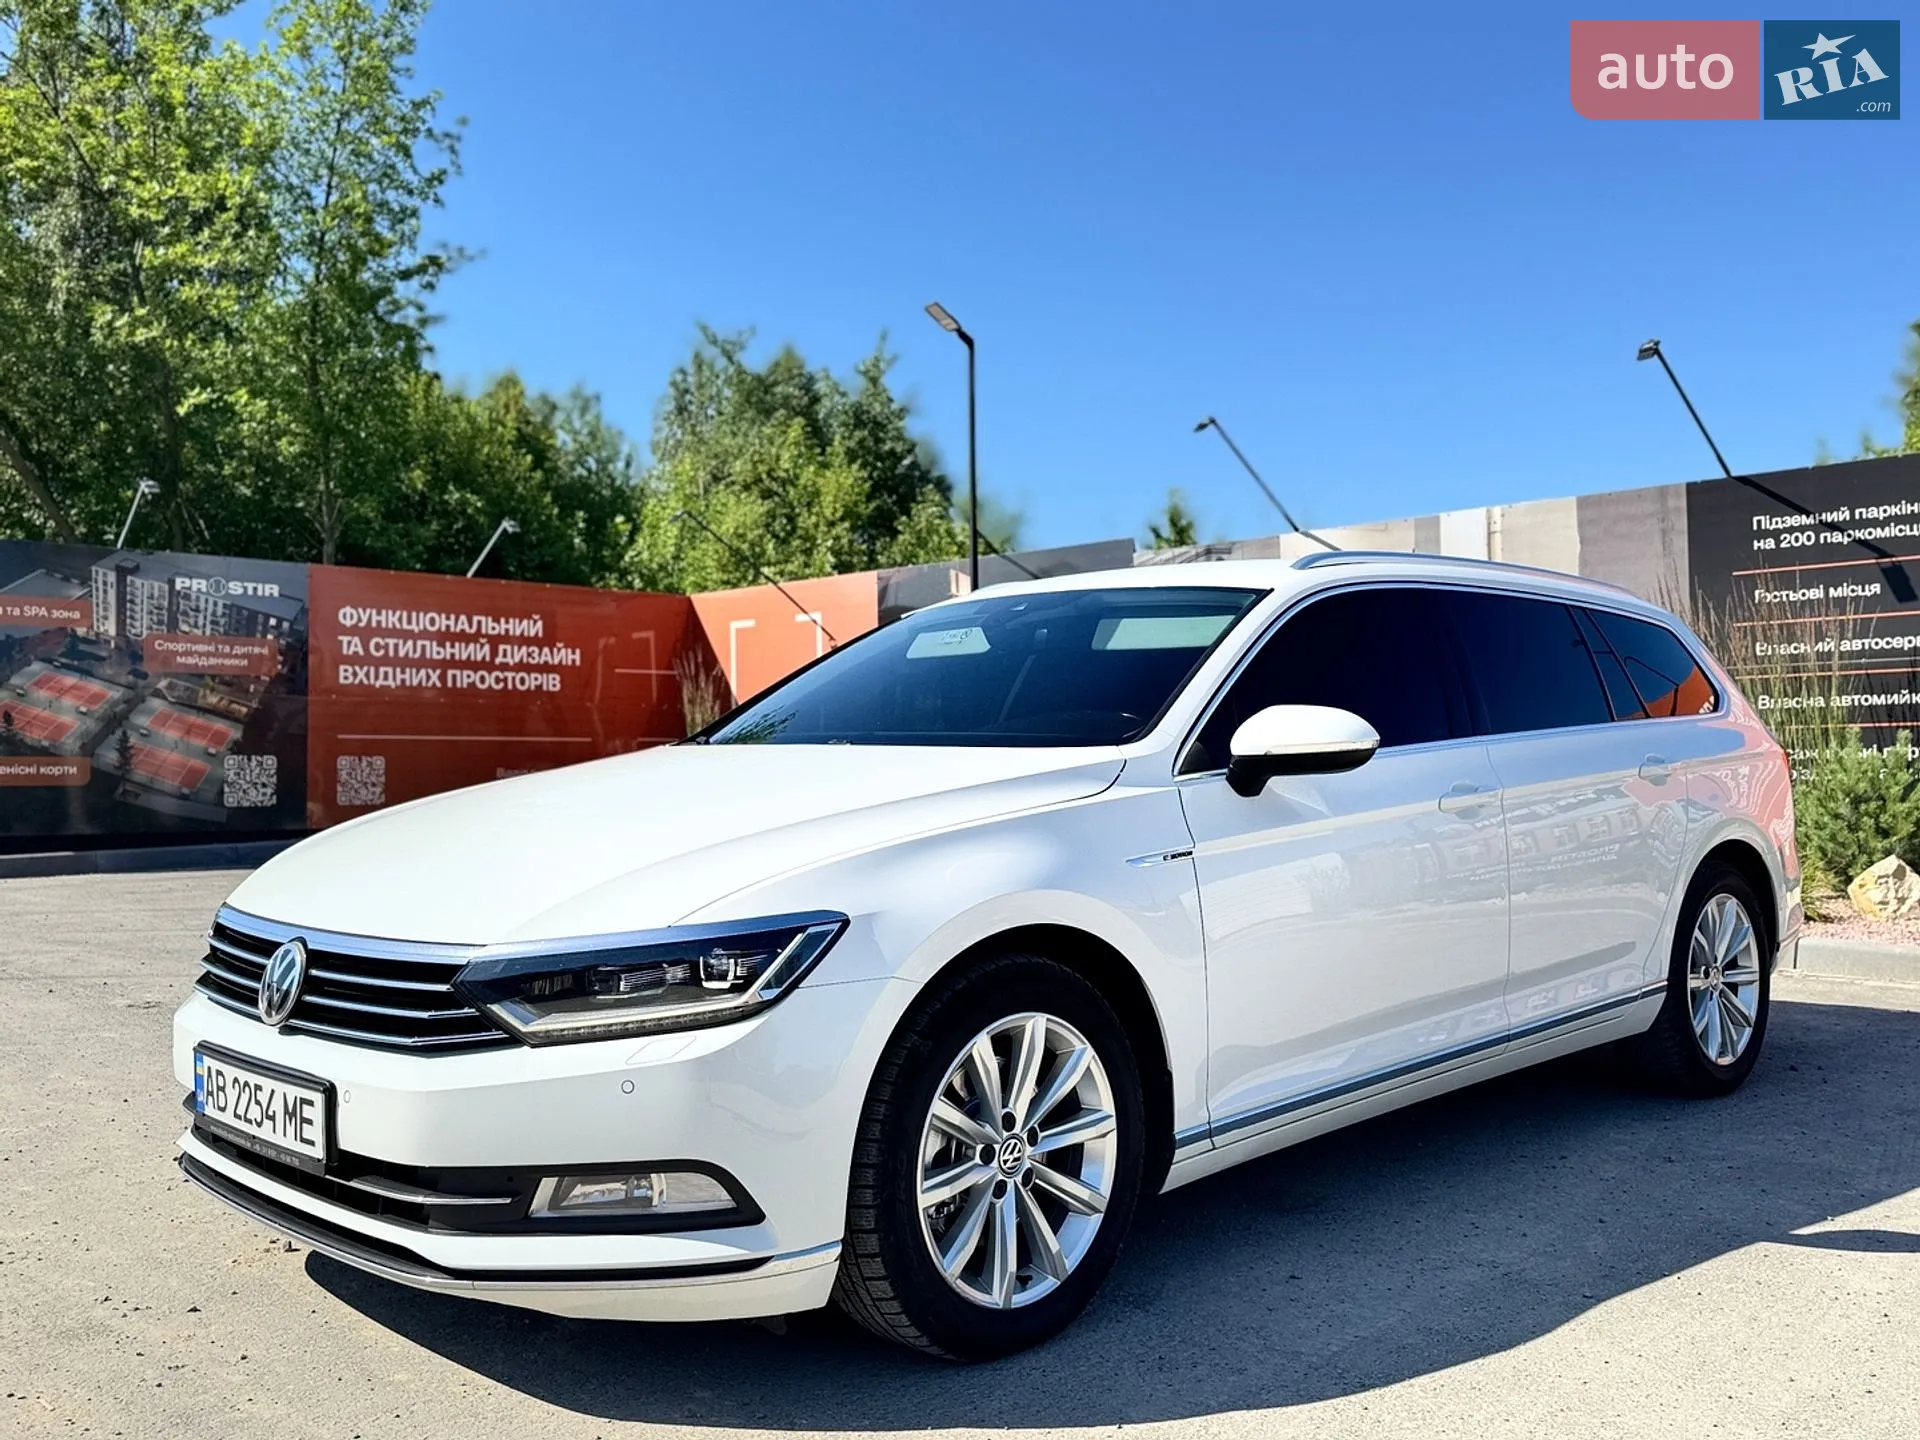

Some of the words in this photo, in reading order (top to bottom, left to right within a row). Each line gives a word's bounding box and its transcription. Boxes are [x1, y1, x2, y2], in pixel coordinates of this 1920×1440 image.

[1752, 506, 1850, 531] Підземний
[1854, 499, 1920, 520] паркін
[1753, 538, 1776, 550] на
[1779, 531, 1815, 548] 200
[1819, 522, 1920, 545] паркомісц
[174, 576, 280, 598] PROSTIR
[1754, 584, 1824, 604] Гостьові
[1828, 582, 1881, 598] місця
[5, 606, 21, 617] та
[23, 604, 48, 618] SPA
[50, 608, 81, 620] зона
[337, 605, 544, 638] ФУНКЦІОНАЛЬНИЙ
[217, 644, 231, 653] та
[337, 635, 364, 656] ТА
[369, 636, 491, 663] СТИЛЬНИЙ
[494, 641, 581, 667] ДИЗАЙН
[338, 664, 442, 689] ВХІДНИХ
[446, 668, 561, 692] ПРОСТОРІВ
[39, 765, 77, 776] корти
[206, 1065, 228, 1113] AB
[232, 1076, 277, 1135] 2254
[283, 1091, 316, 1147] ME
